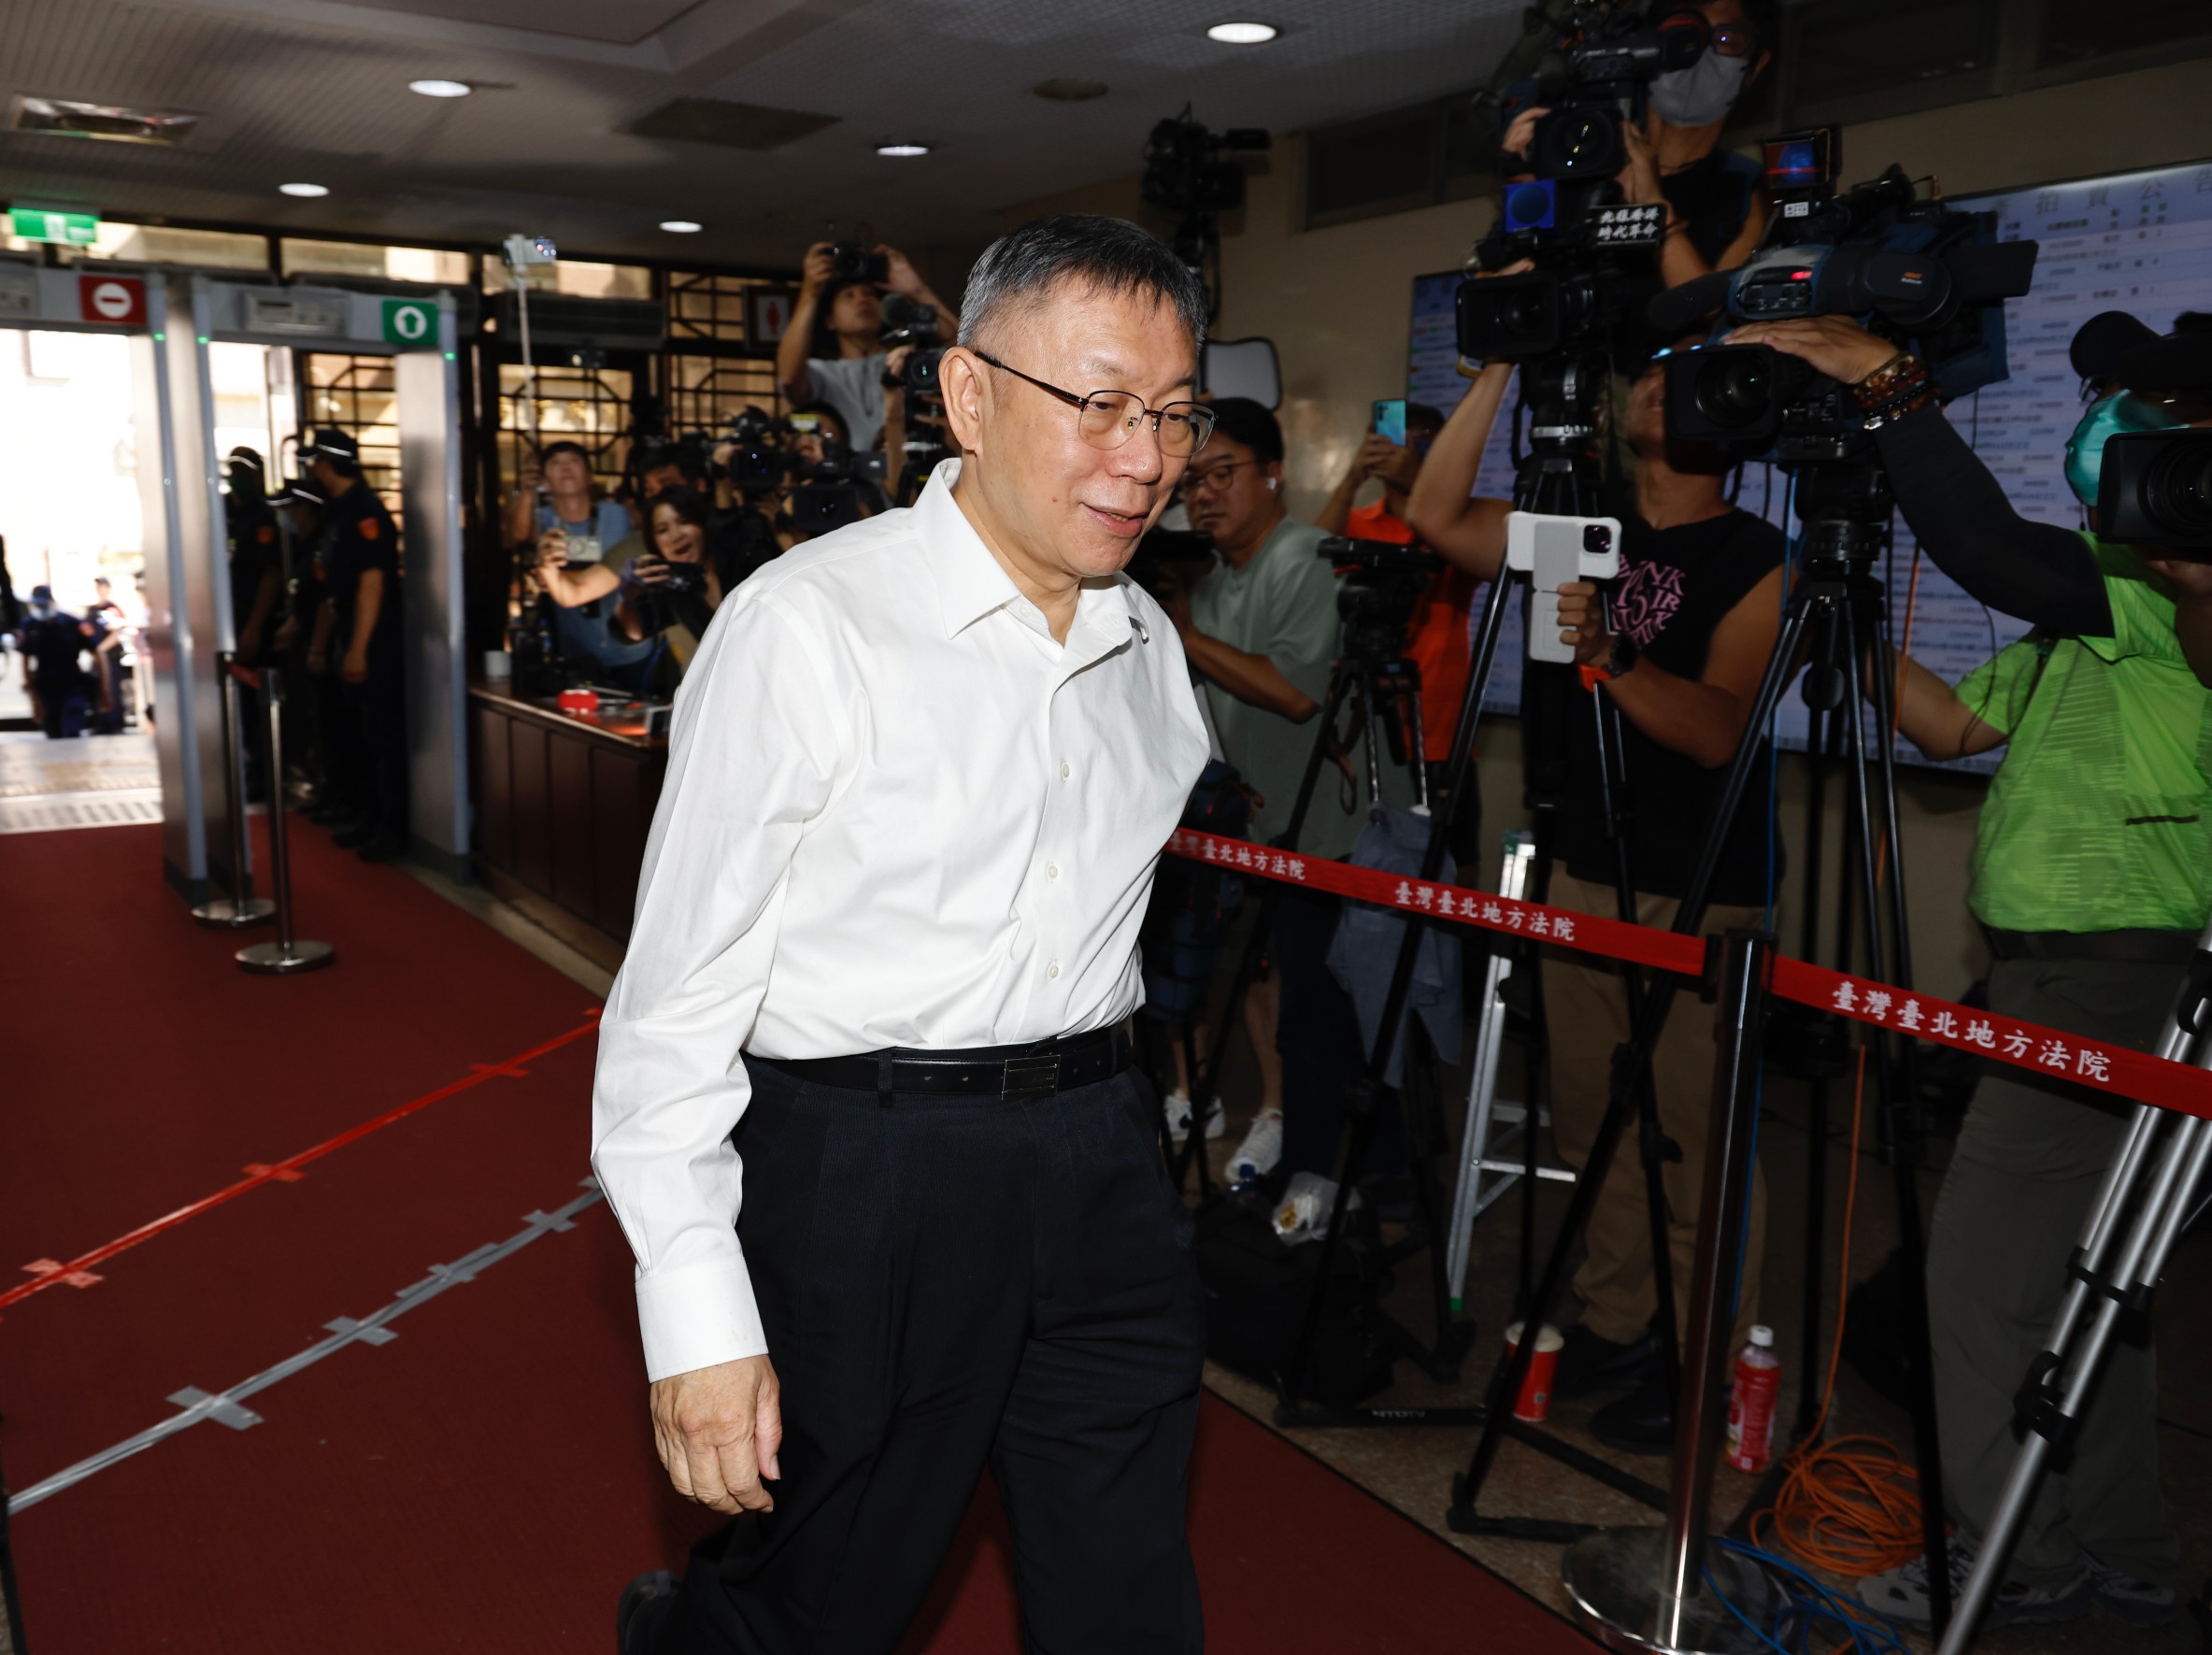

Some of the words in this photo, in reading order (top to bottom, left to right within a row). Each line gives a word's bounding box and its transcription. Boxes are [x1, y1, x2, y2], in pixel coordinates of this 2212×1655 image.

[1597, 222, 1658, 240] 時代革命
[1395, 880, 1576, 942] 臺灣臺北地方法院
[1832, 980, 2111, 1082] 臺灣臺北地方法院
